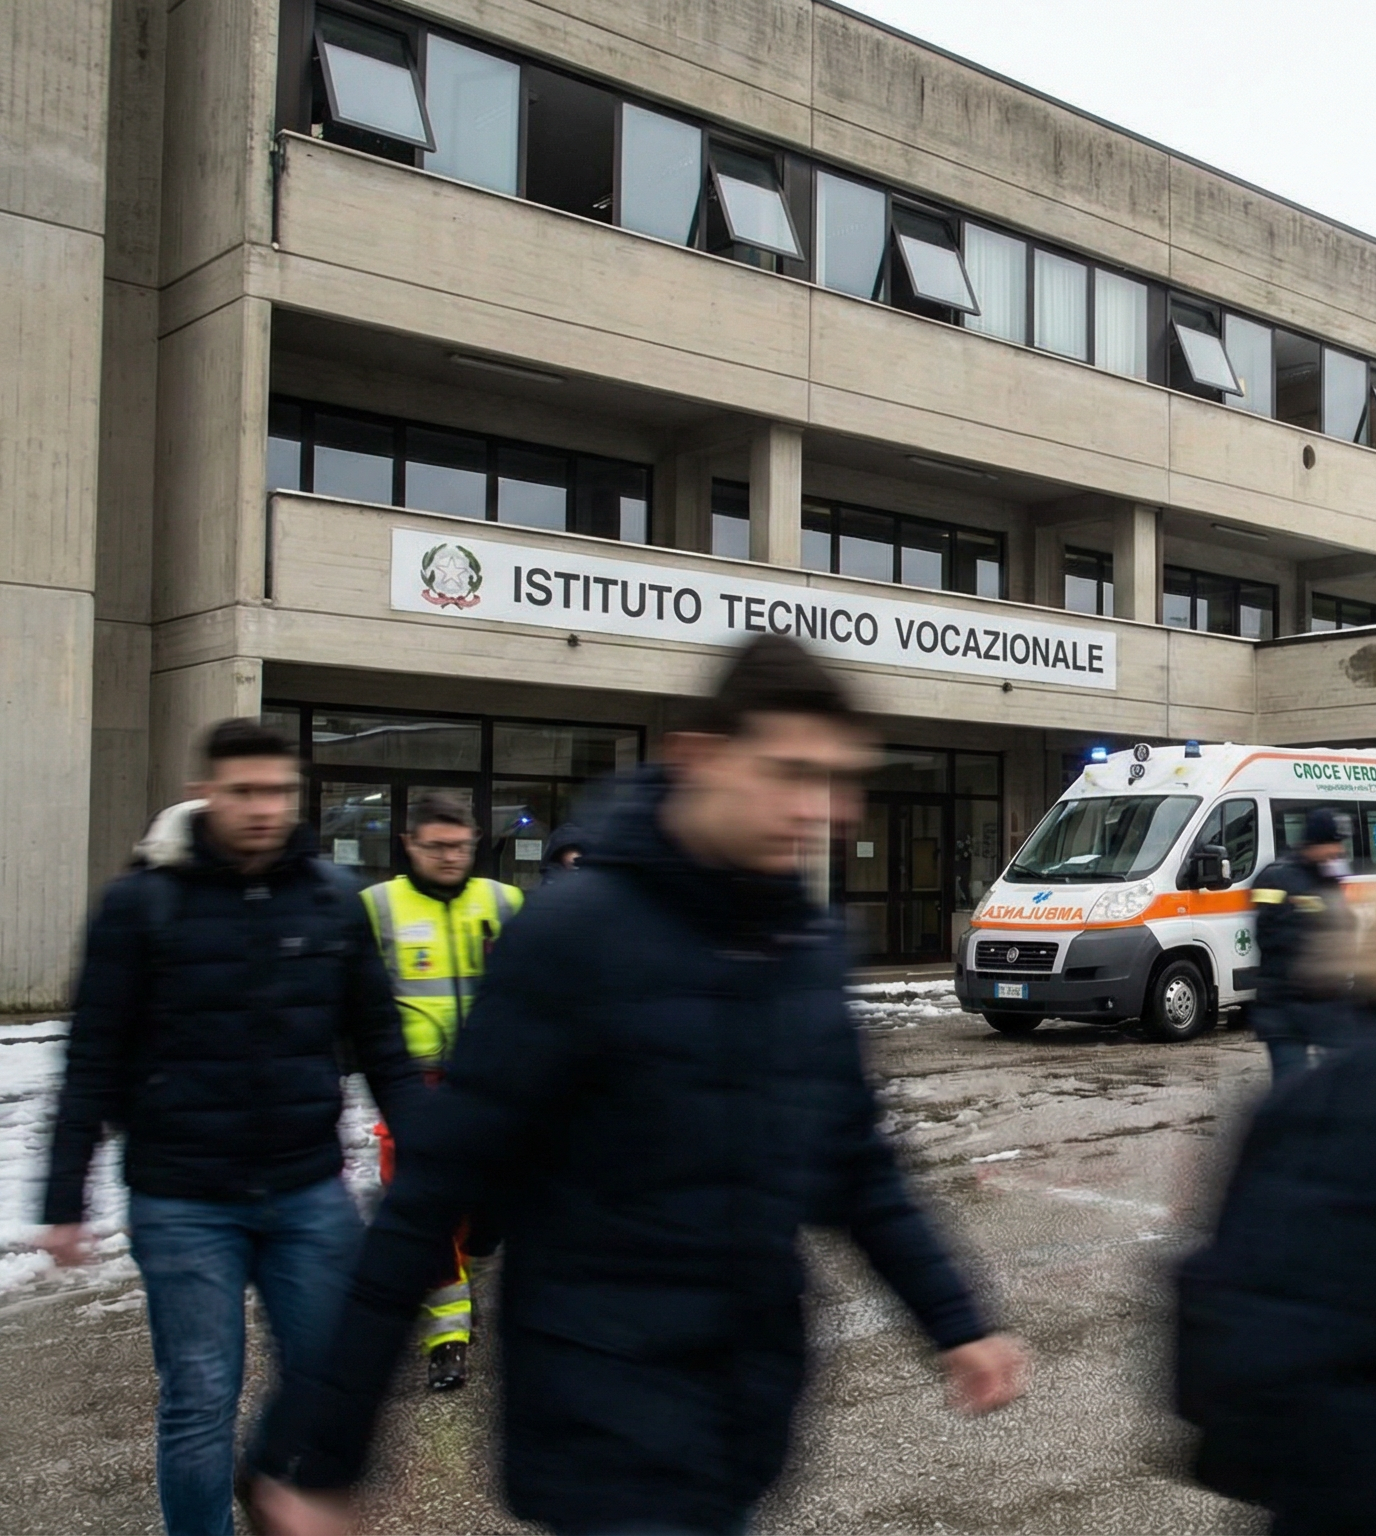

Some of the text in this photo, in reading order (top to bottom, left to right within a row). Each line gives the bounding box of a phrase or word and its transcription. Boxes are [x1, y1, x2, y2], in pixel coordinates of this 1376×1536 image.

[514, 566, 1104, 673] ISTITUTO TECNICO VOCAZIONALE
[1293, 763, 1341, 780] CROCE
